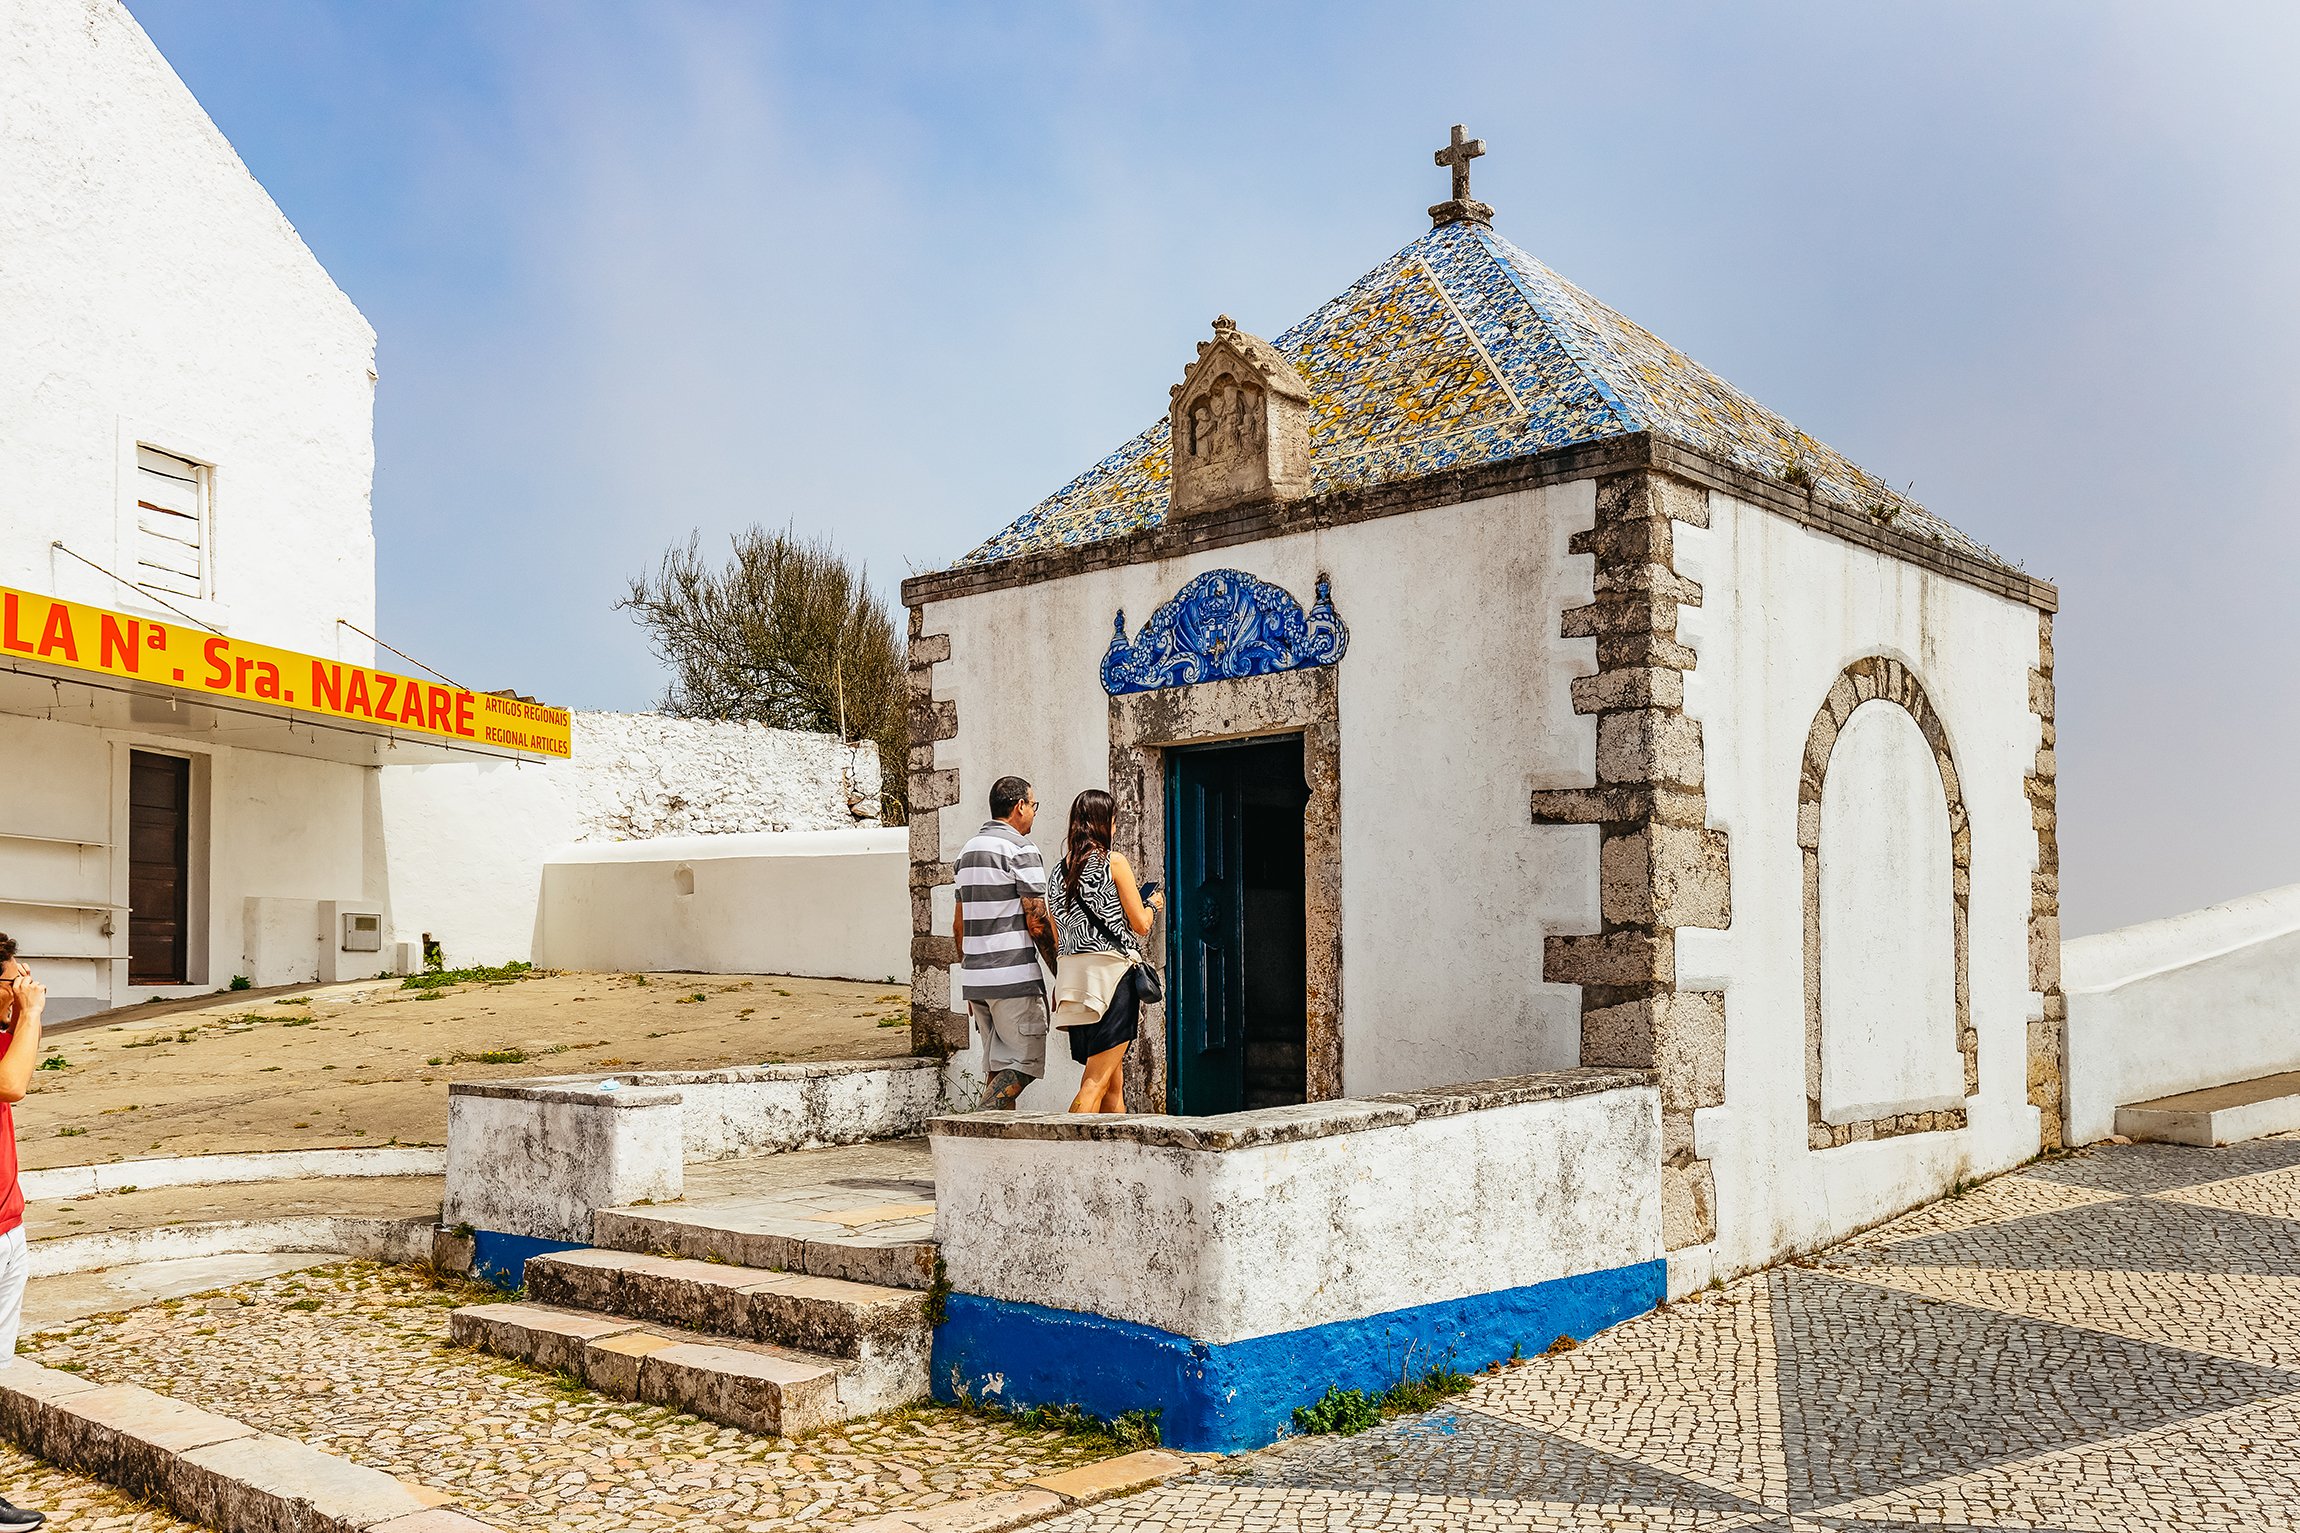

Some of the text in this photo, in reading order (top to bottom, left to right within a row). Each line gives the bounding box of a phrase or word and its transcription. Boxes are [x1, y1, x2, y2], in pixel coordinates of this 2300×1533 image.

[3, 592, 79, 662] LA
[203, 637, 295, 703] Sra.
[311, 660, 475, 738] NAZARÉ
[485, 697, 568, 727] ARTIGOS REGIONAIS
[485, 725, 568, 755] REGIONAL ARTICLES
